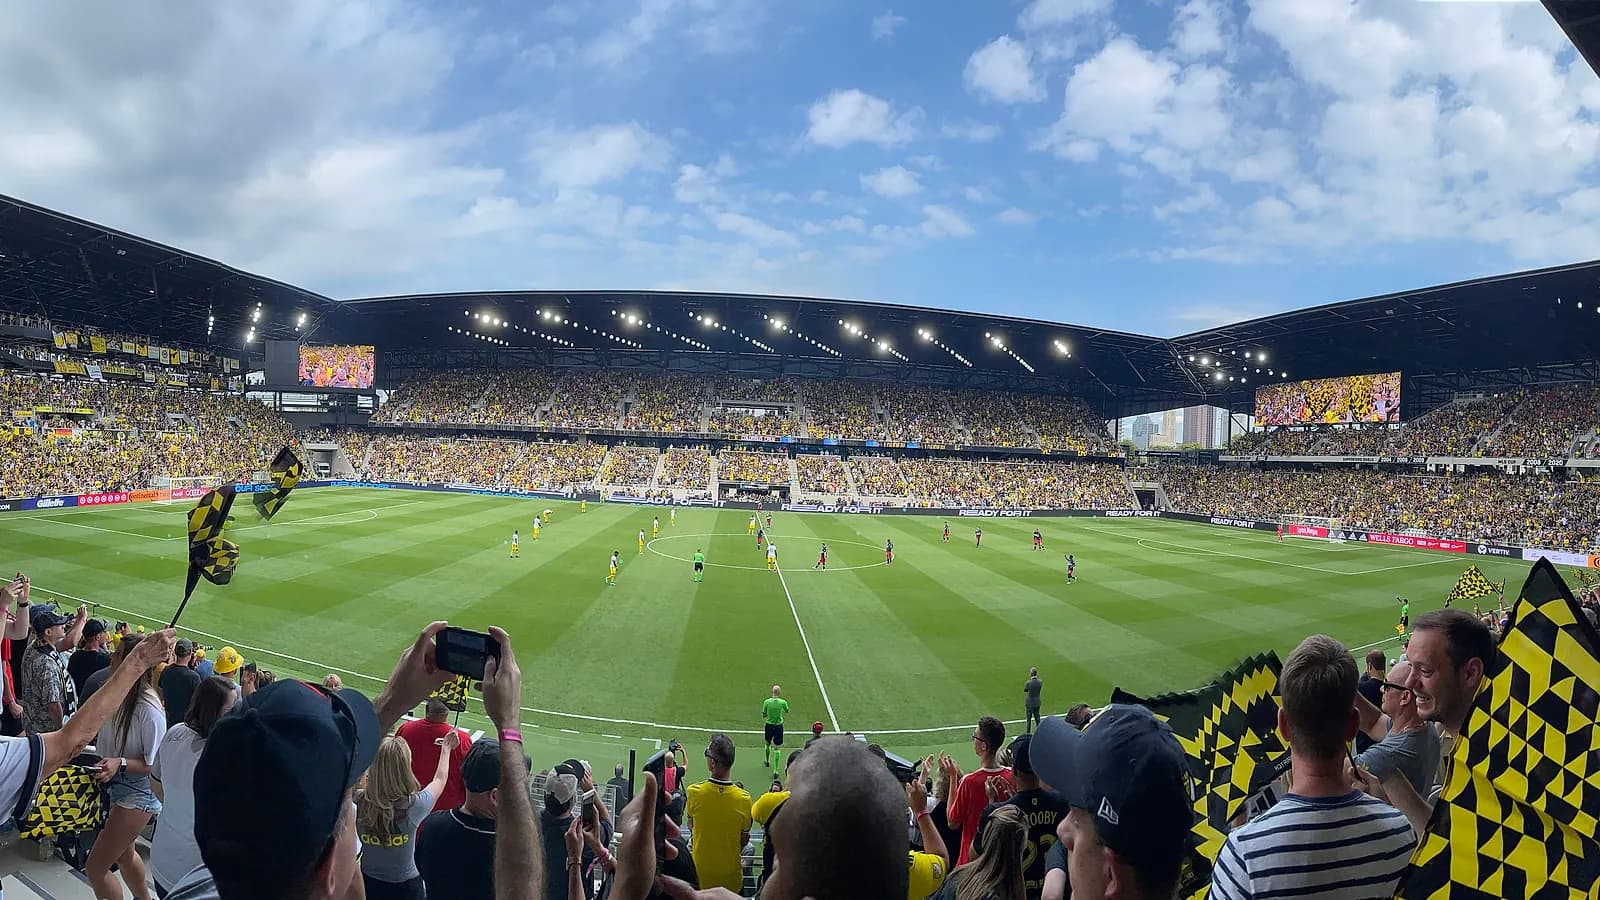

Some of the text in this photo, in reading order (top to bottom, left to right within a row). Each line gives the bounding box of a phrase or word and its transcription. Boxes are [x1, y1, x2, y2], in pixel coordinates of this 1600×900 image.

[36, 498, 65, 509] Gillette
[958, 509, 999, 517] READY
[1210, 517, 1233, 526] READY
[1233, 520, 1247, 528] FOR
[1369, 533, 1391, 543] WELLS
[1391, 536, 1415, 546] FARGO
